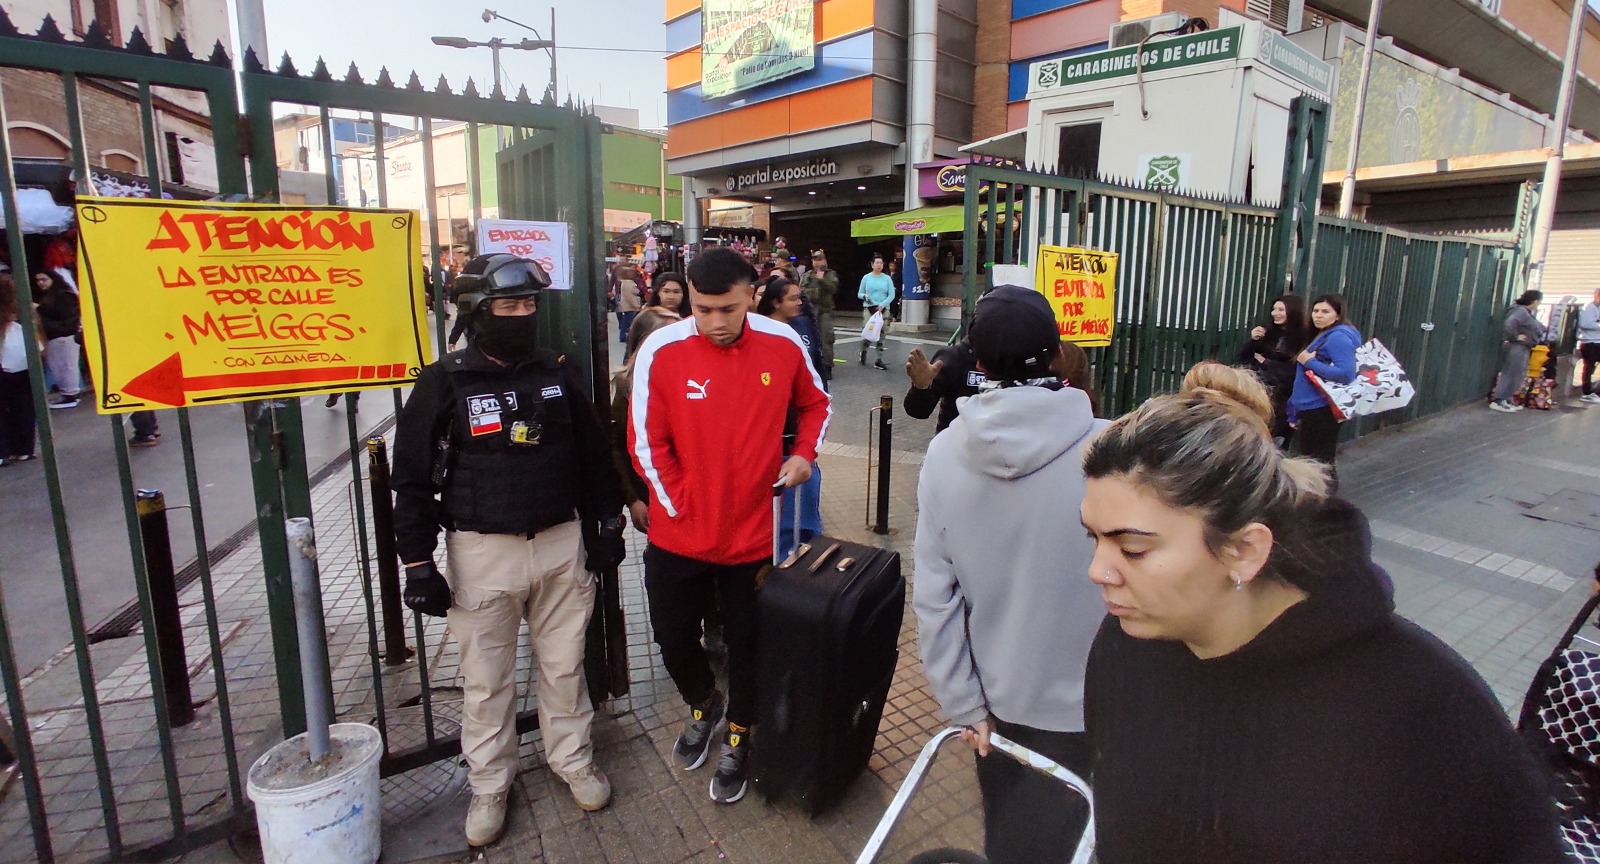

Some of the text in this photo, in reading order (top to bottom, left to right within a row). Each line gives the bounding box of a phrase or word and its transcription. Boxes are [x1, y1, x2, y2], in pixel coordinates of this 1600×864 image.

[757, 62, 764, 71] de
[1067, 36, 1230, 78] CARABINEROS DE CHILE
[738, 164, 770, 191] portal
[772, 158, 836, 184] exposición
[145, 209, 375, 254] ATENCIÓN
[488, 228, 551, 242] ENTRADA
[506, 243, 534, 257] POR
[157, 263, 363, 288] LA ENTRADA ES
[206, 287, 336, 306] POR CALLE
[1054, 279, 1105, 300] ENTRADA
[1062, 302, 1085, 317] POR
[182, 307, 354, 346] MEIGGS
[223, 352, 346, 368] CON ALAMEDA
